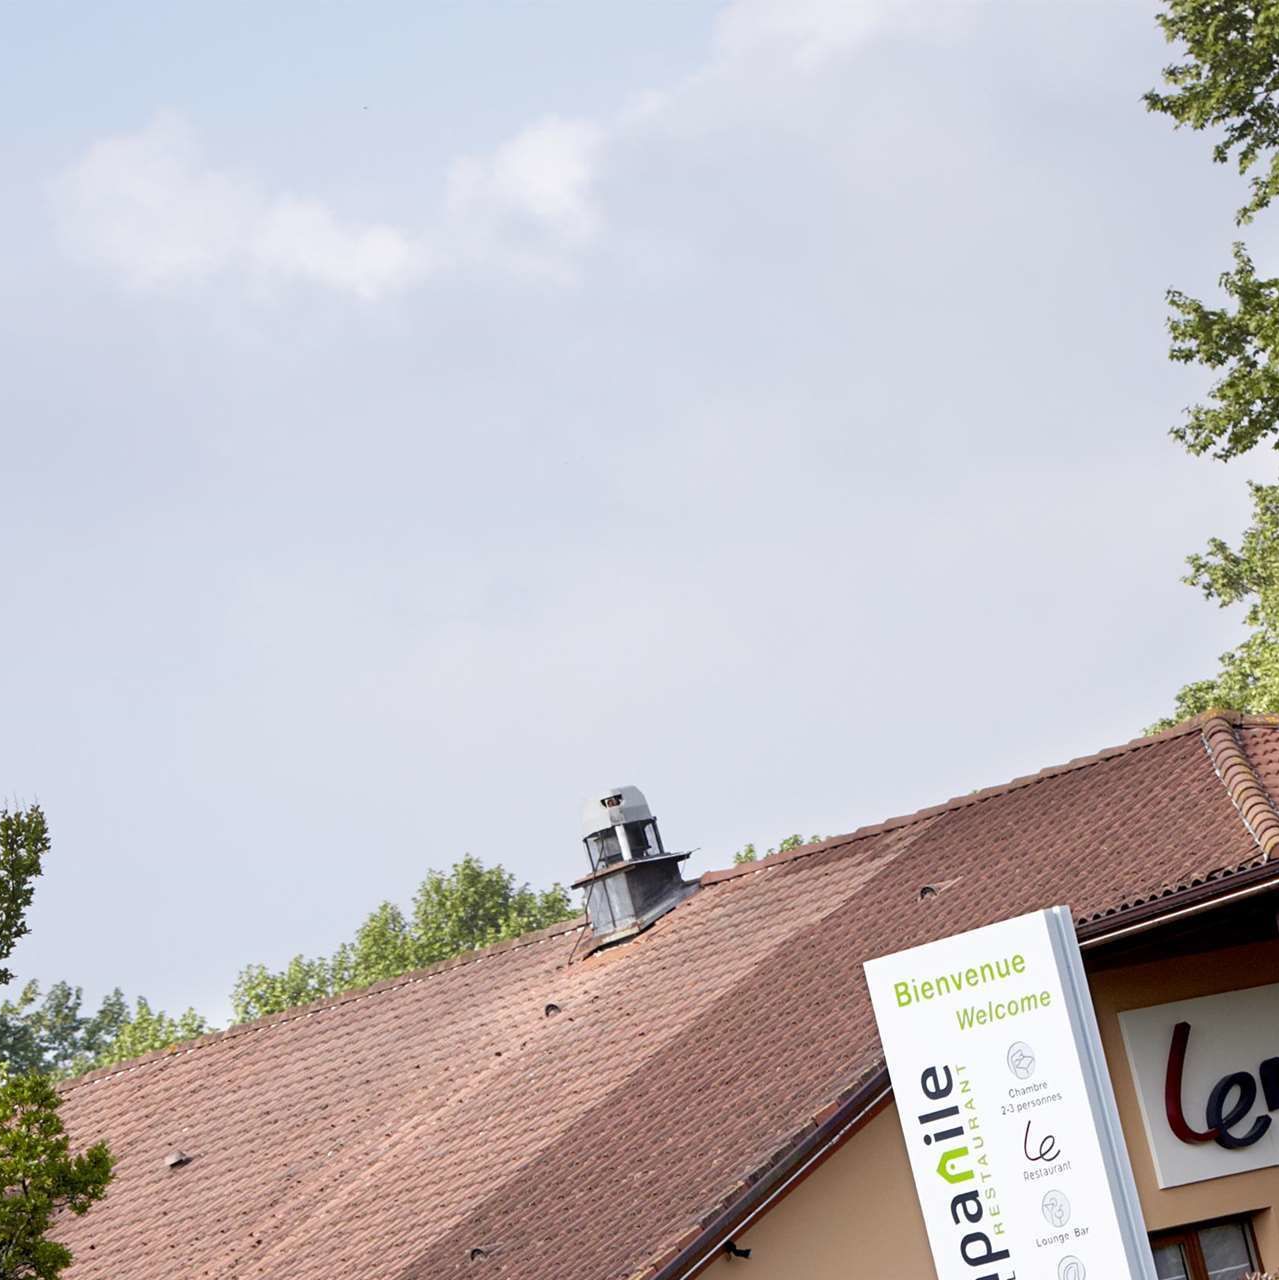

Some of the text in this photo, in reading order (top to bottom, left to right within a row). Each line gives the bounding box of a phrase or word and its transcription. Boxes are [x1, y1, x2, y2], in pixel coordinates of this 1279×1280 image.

[894, 954, 1026, 1008] Bienvenue
[956, 990, 1051, 1031] Welcome
[1001, 1092, 1063, 1115] 2-3 personnes
[1008, 1081, 1048, 1098] Chambre
[1165, 1021, 1272, 1149] Le
[956, 1064, 1004, 1235] RESTAURANT
[1024, 1120, 1061, 1162] Le
[1023, 1160, 1072, 1181] Restaurant
[1036, 1226, 1090, 1248] Lounge Bar
